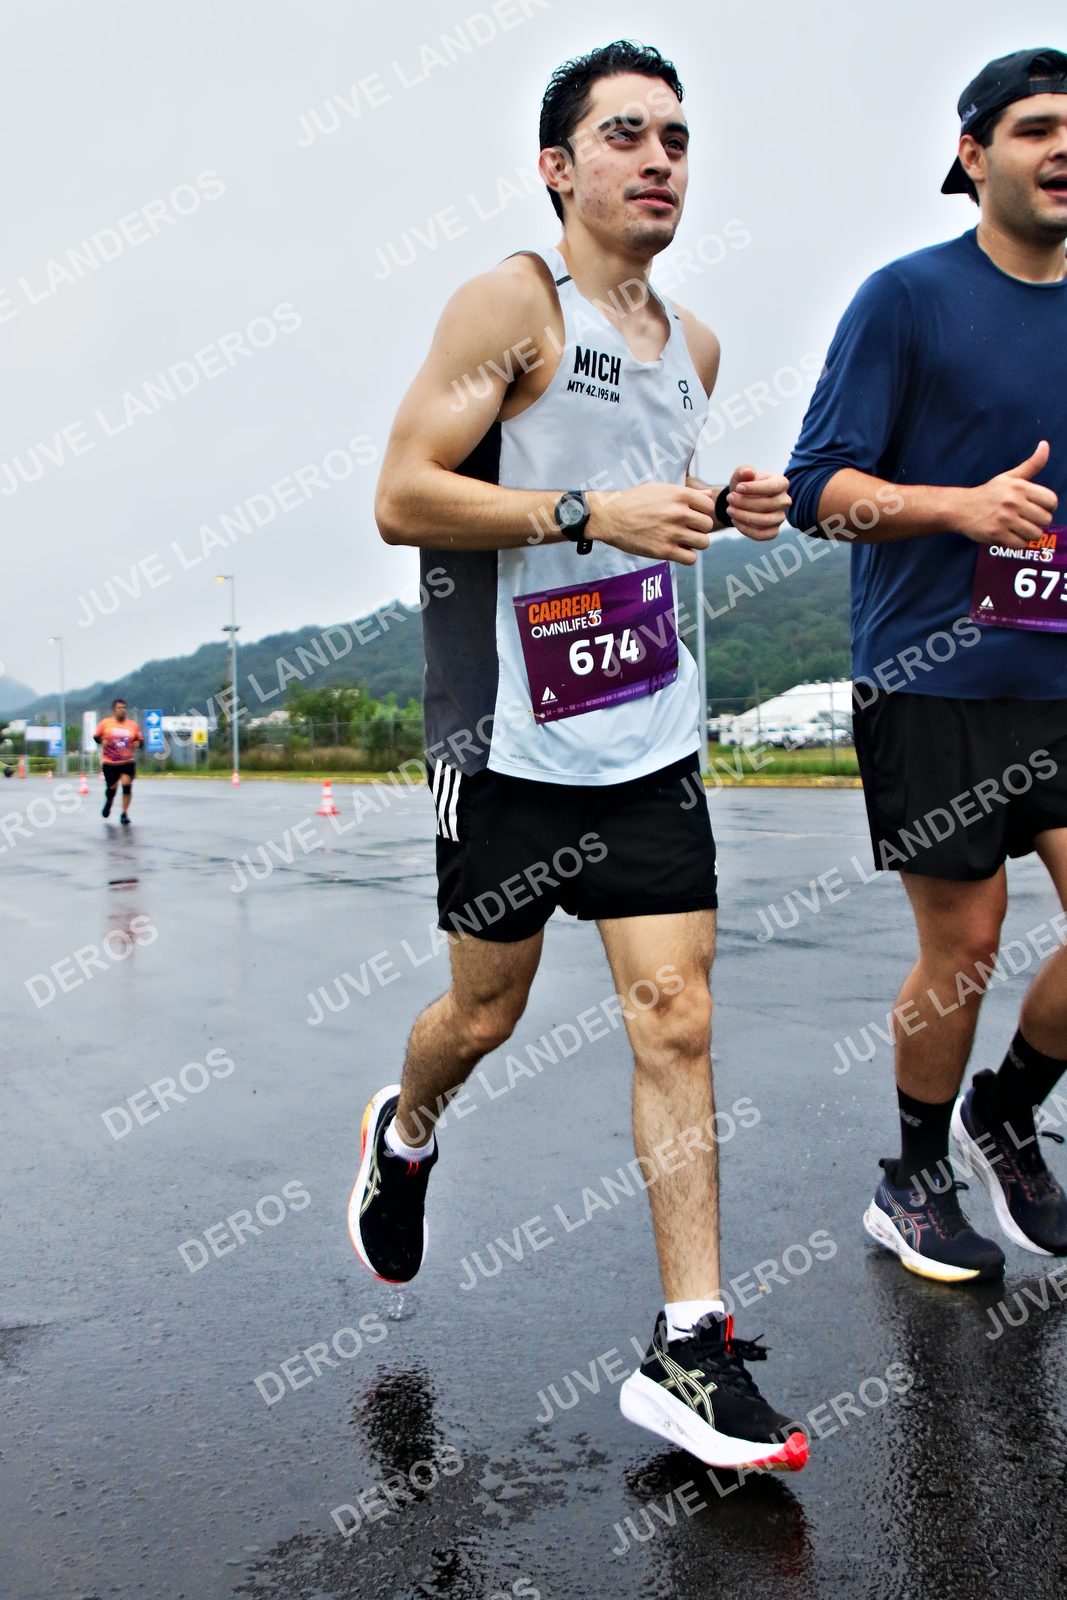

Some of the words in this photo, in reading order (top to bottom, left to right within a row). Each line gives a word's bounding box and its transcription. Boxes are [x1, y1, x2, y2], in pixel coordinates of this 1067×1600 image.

[573, 346, 621, 386] MICH
[567, 380, 585, 394] MTY
[586, 385, 609, 401] 42.195
[609, 390, 620, 403] KM
[641, 574, 663, 603] 15K
[528, 591, 602, 625] CARRERA
[569, 628, 640, 676] 674
[149, 728, 161, 745] E
